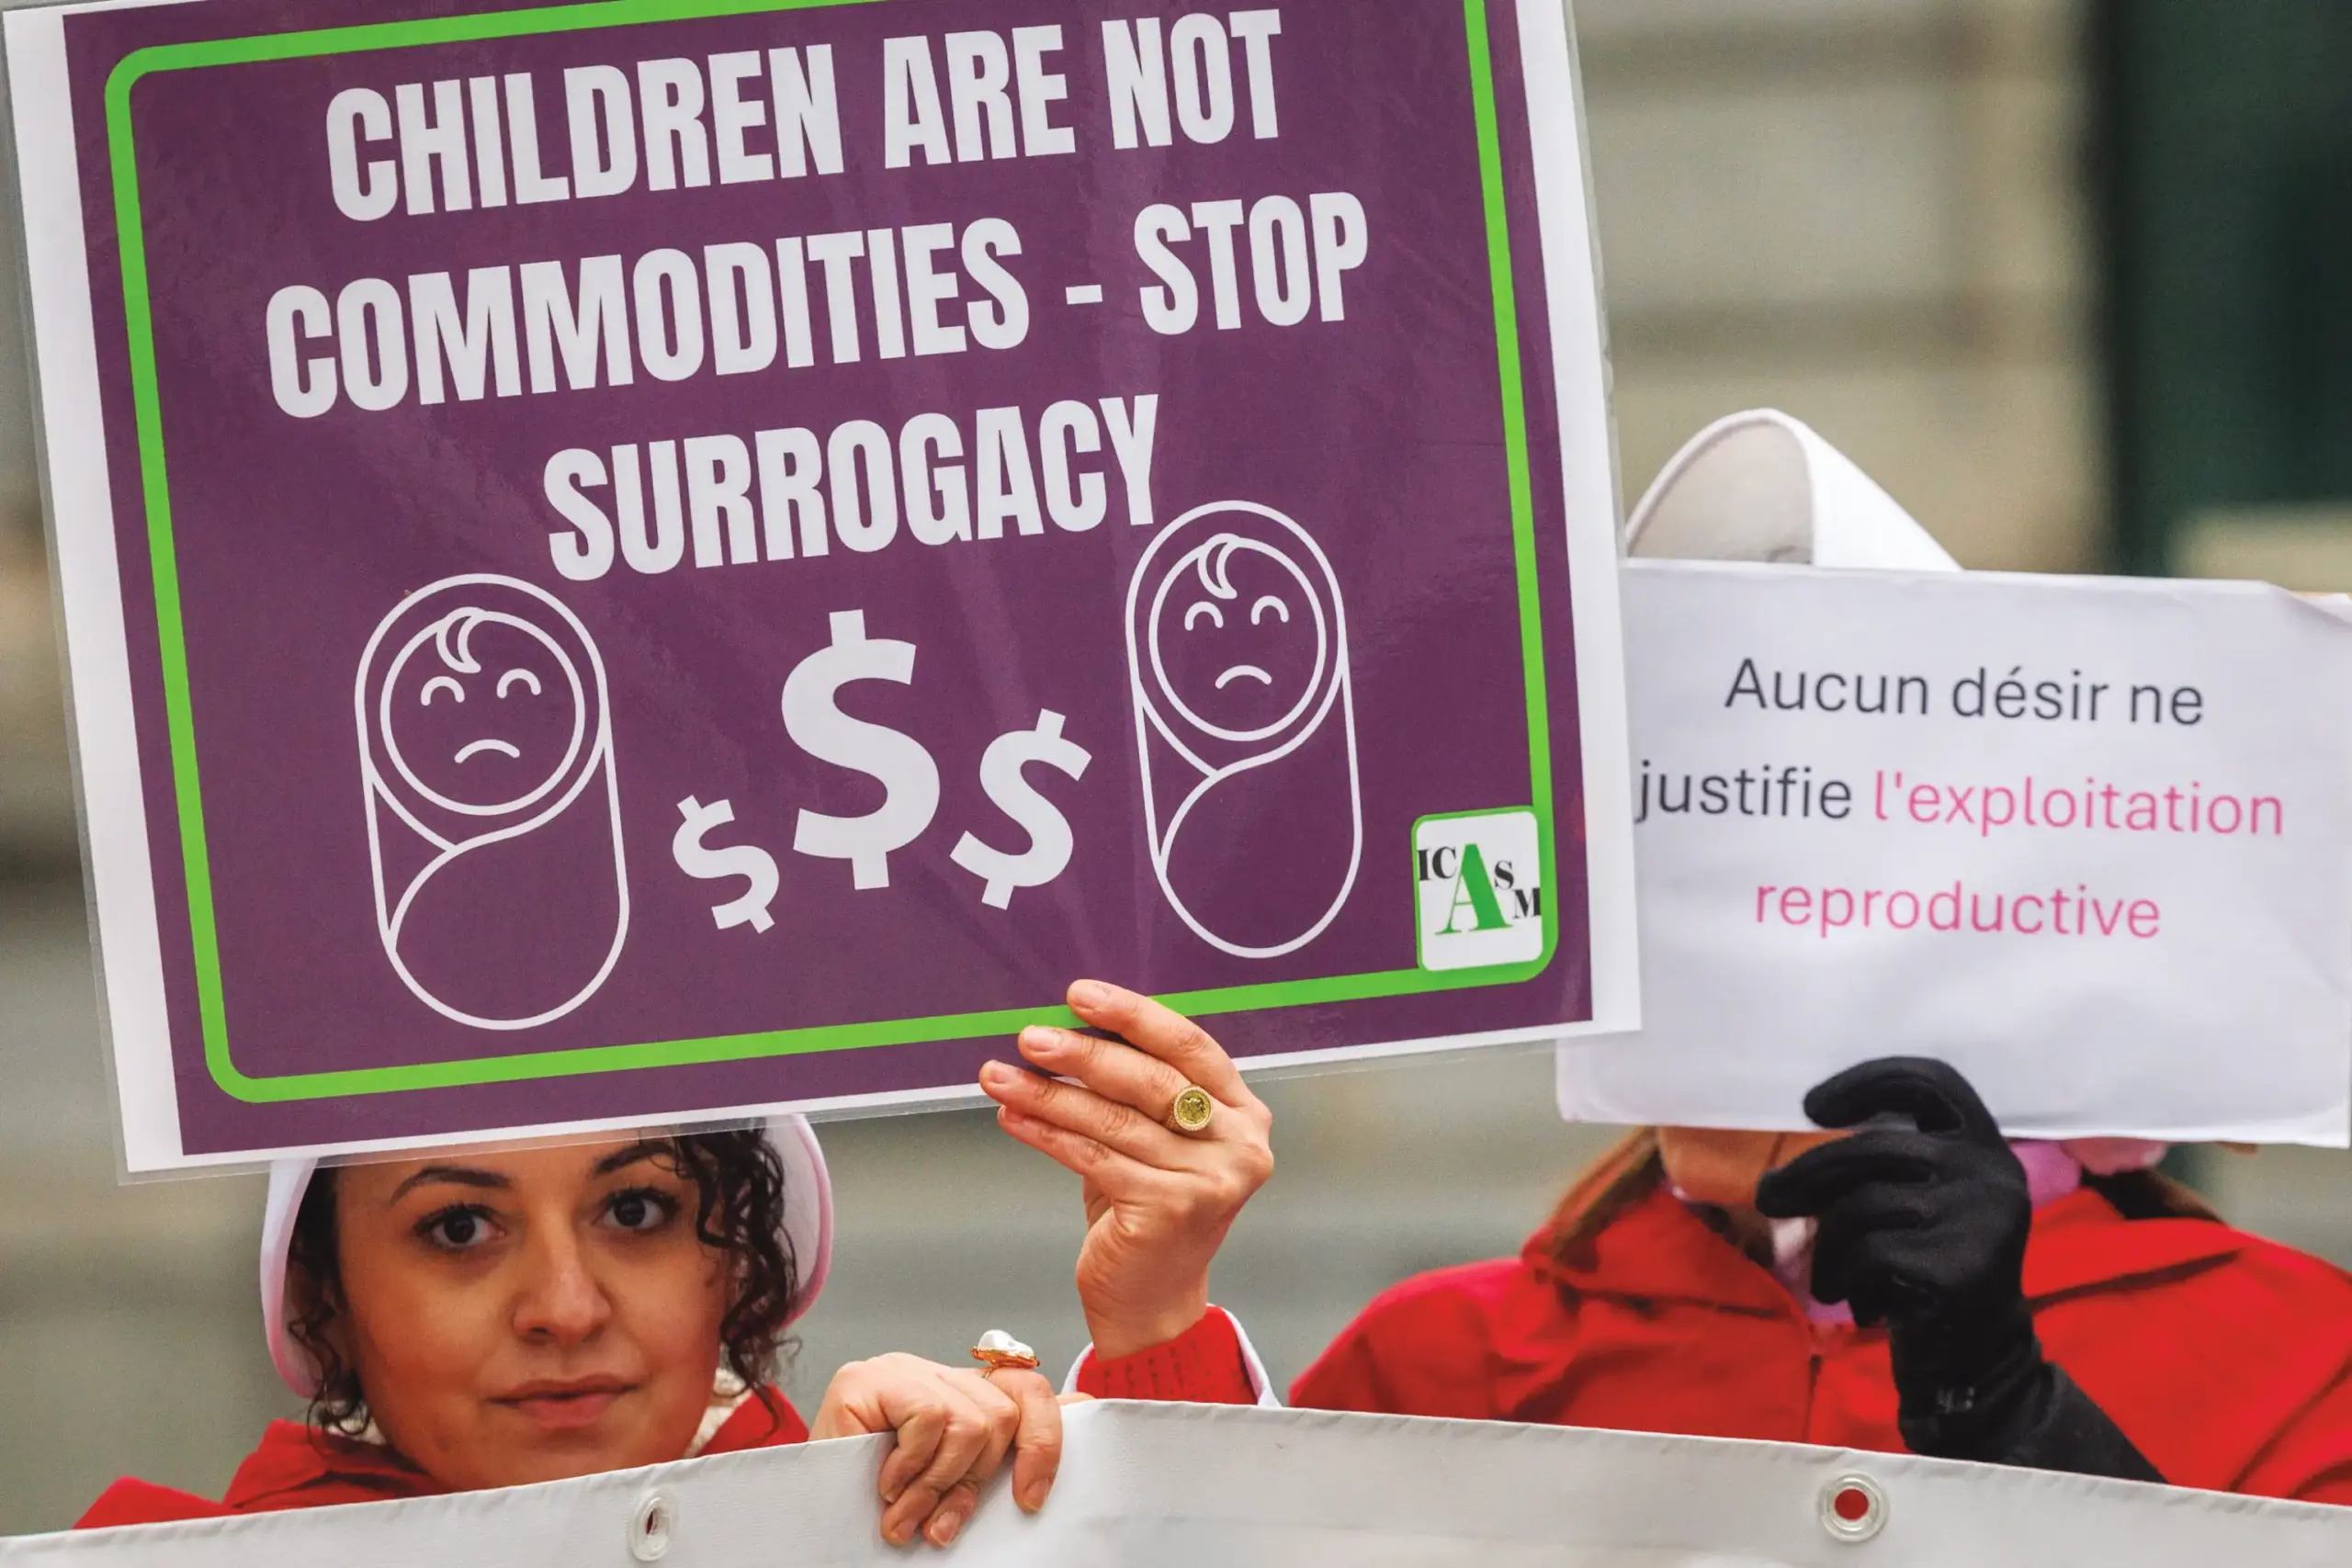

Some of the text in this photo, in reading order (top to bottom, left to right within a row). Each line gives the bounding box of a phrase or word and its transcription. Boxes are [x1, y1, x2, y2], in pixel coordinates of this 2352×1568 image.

[326, 8, 1282, 221] CHILDREN ARE NOT
[266, 218, 1030, 418] COMMODITIES
[1134, 191, 1368, 335] STOP
[543, 393, 1159, 581] SURROGACY
[1724, 657, 2203, 726] Aucun désir ne
[1634, 758, 2283, 837] justifie l'exploitation
[1756, 881, 2160, 938] reproductive
